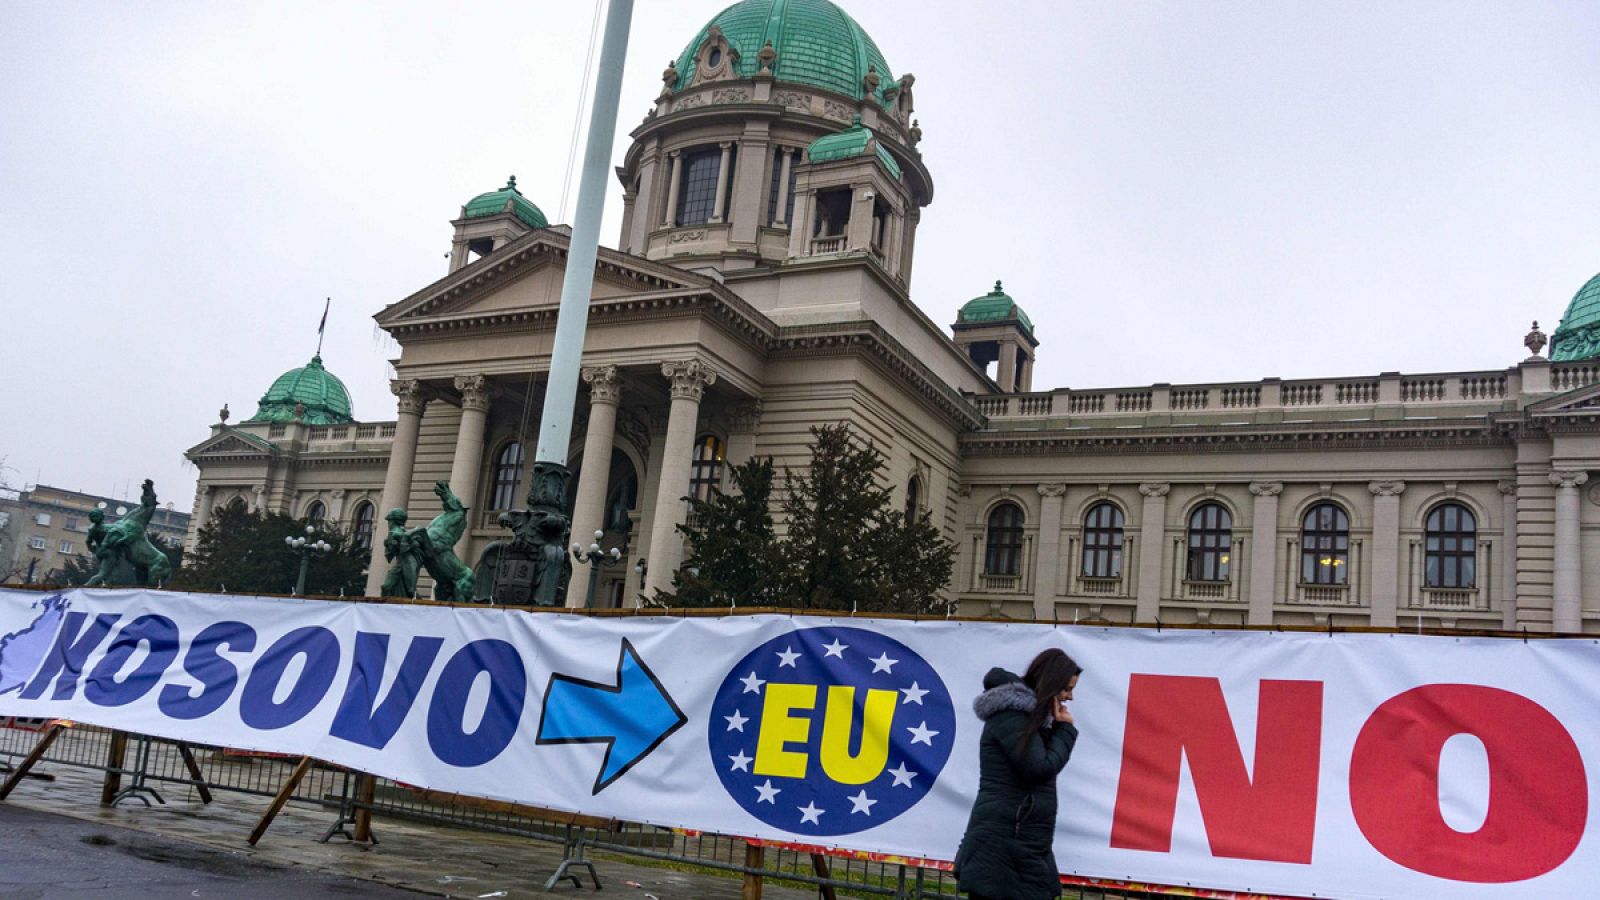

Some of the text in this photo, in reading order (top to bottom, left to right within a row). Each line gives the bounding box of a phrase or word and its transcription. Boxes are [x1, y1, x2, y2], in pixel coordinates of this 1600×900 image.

[19, 611, 1588, 883] KOSOVO EU NO
